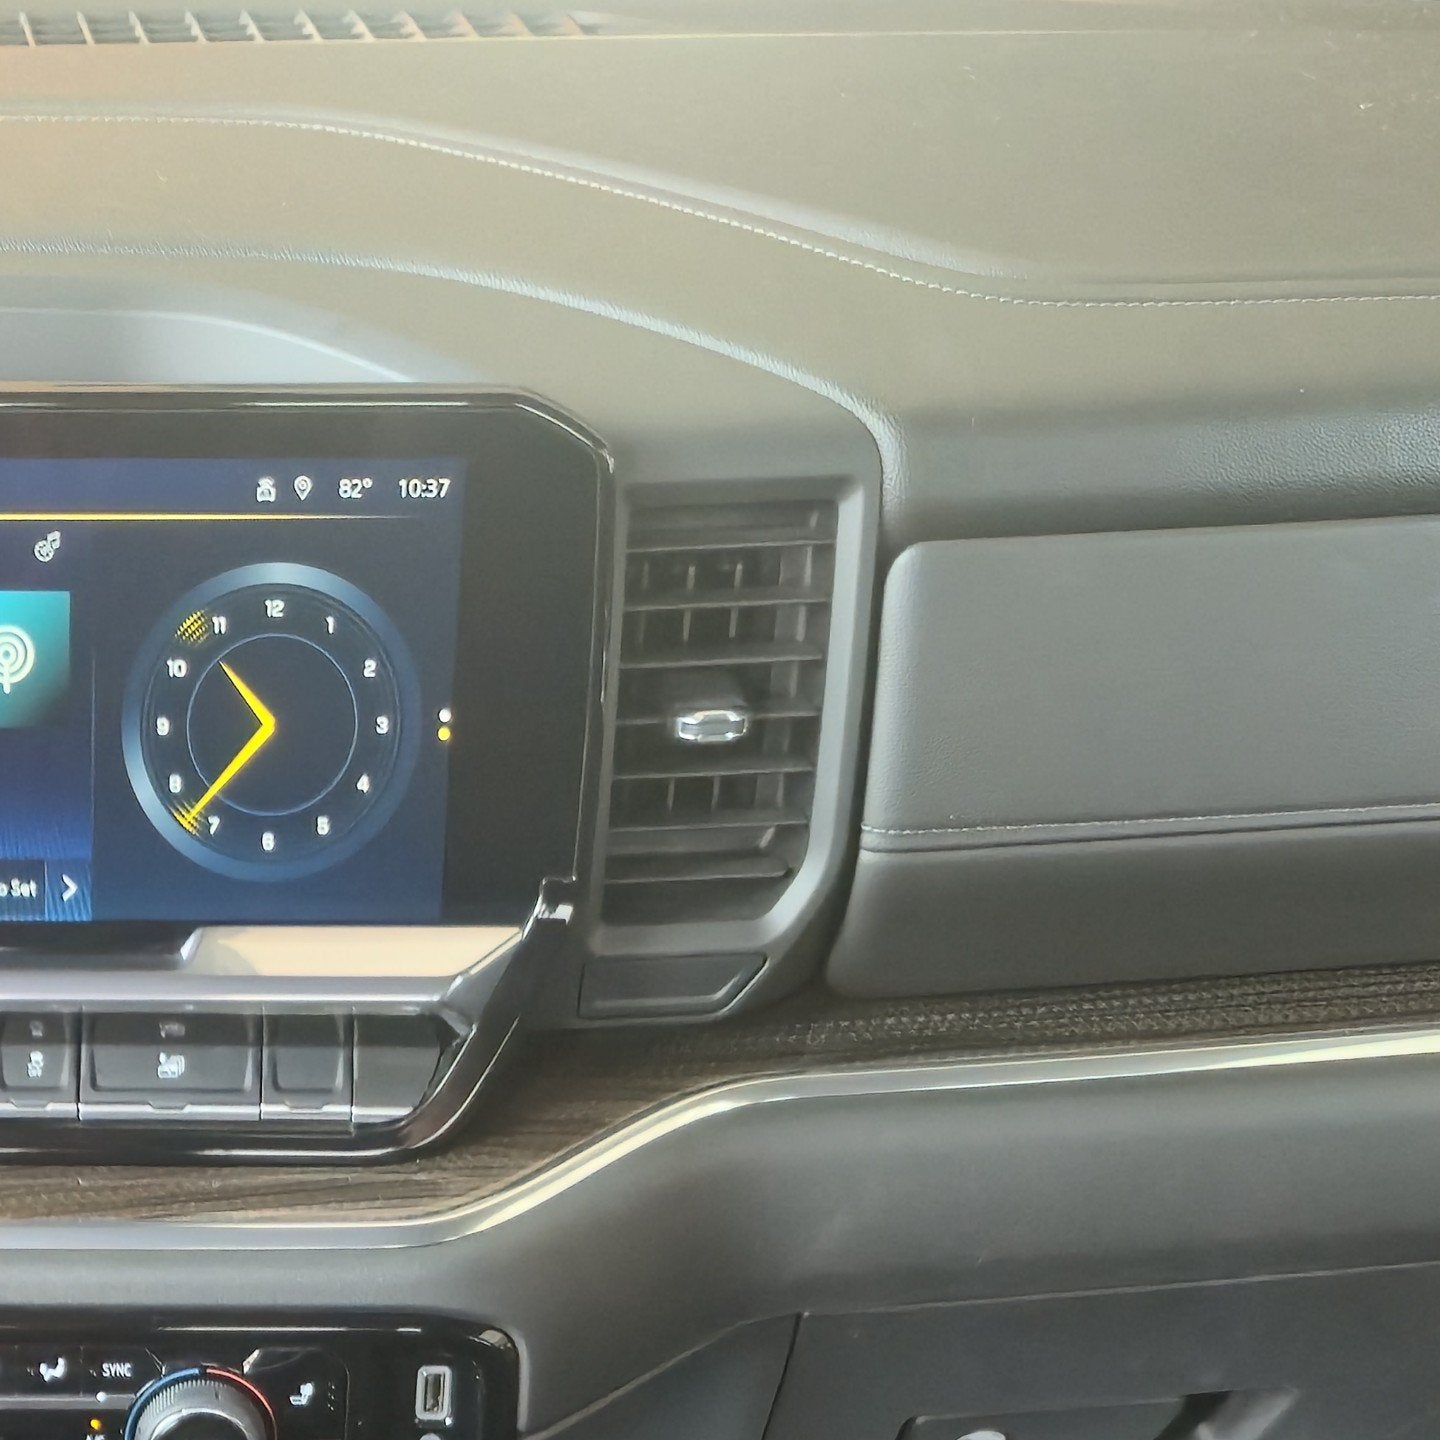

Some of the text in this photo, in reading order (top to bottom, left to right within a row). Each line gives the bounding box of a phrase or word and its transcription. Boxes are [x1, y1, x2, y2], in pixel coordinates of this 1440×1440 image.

[338, 478, 451, 498] 82° 10:37
[265, 599, 284, 617] 12
[211, 615, 227, 634] 11
[325, 615, 335, 634] 1
[166, 659, 187, 678] 10
[363, 658, 376, 677] 2
[156, 717, 169, 736] 9
[376, 715, 389, 734] 3
[169, 774, 182, 793] 8
[356, 773, 370, 793] 4
[208, 816, 220, 835] 7
[316, 816, 330, 835] 5
[261, 831, 275, 851] 6
[10, 878, 37, 898] Set
[102, 1362, 133, 1378] SYNC
